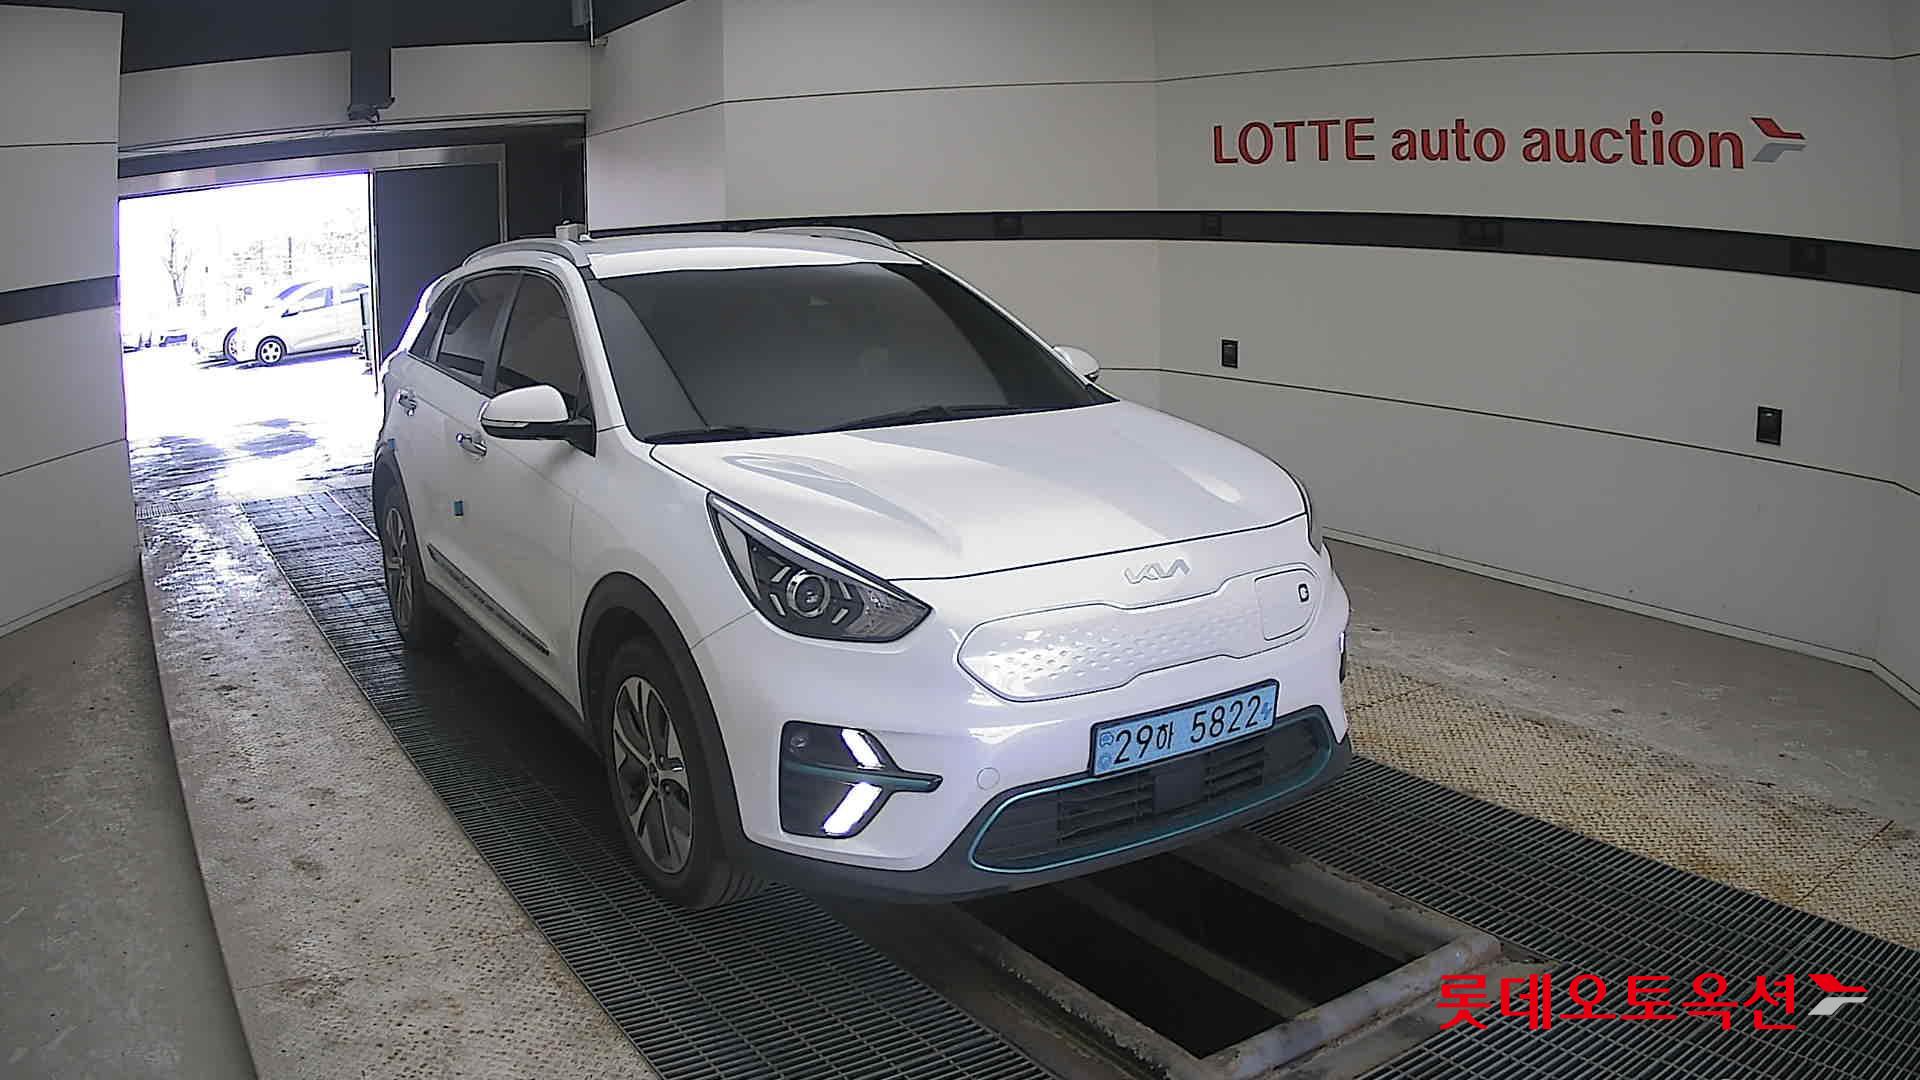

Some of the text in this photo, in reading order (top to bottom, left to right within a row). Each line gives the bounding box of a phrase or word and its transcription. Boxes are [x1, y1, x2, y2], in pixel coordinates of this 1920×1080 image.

[1213, 110, 1744, 170] LOTTE auto auction
[1113, 695, 1261, 765] 29하 5822
